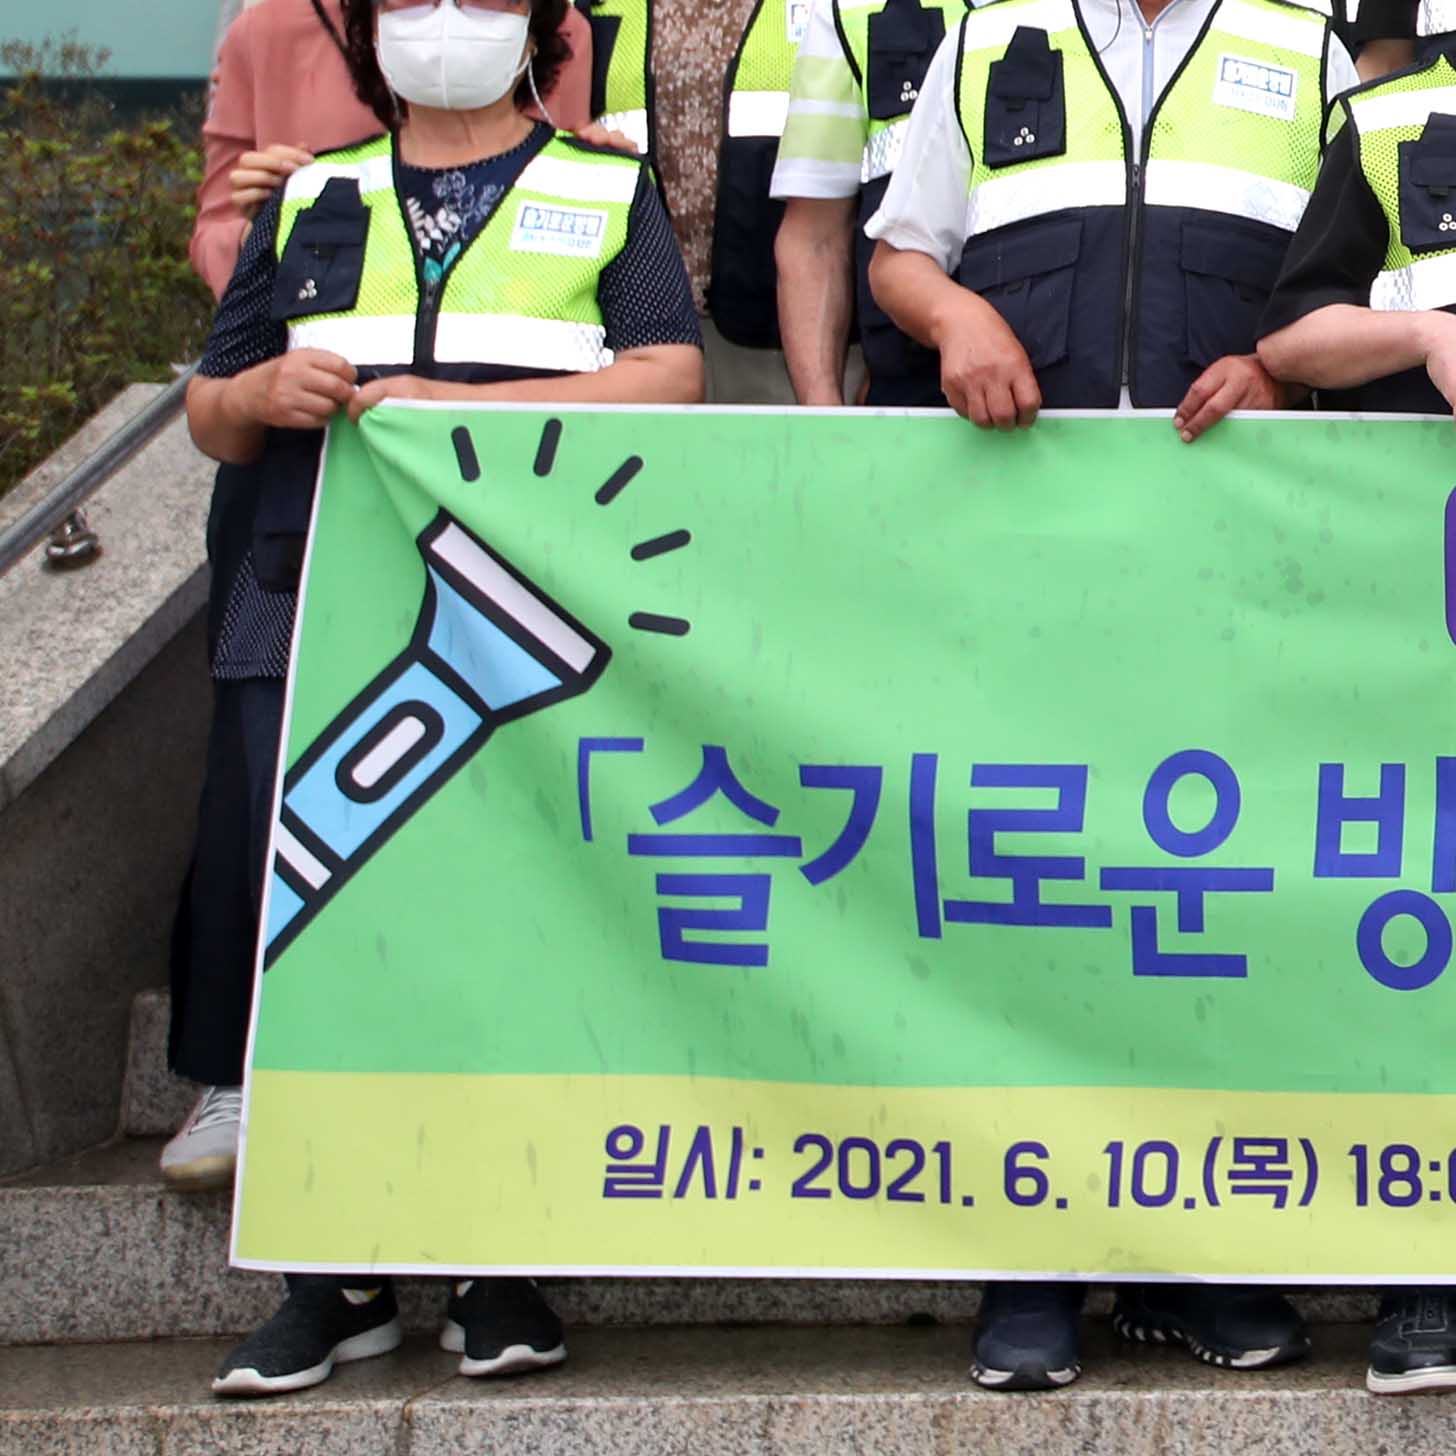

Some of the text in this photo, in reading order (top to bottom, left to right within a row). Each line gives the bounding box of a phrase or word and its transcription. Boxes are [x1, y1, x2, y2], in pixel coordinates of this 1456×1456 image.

[603, 1124, 764, 1200] 일시:
[792, 1133, 974, 1208] 2021.
[1004, 1140, 1068, 1210] 6.
